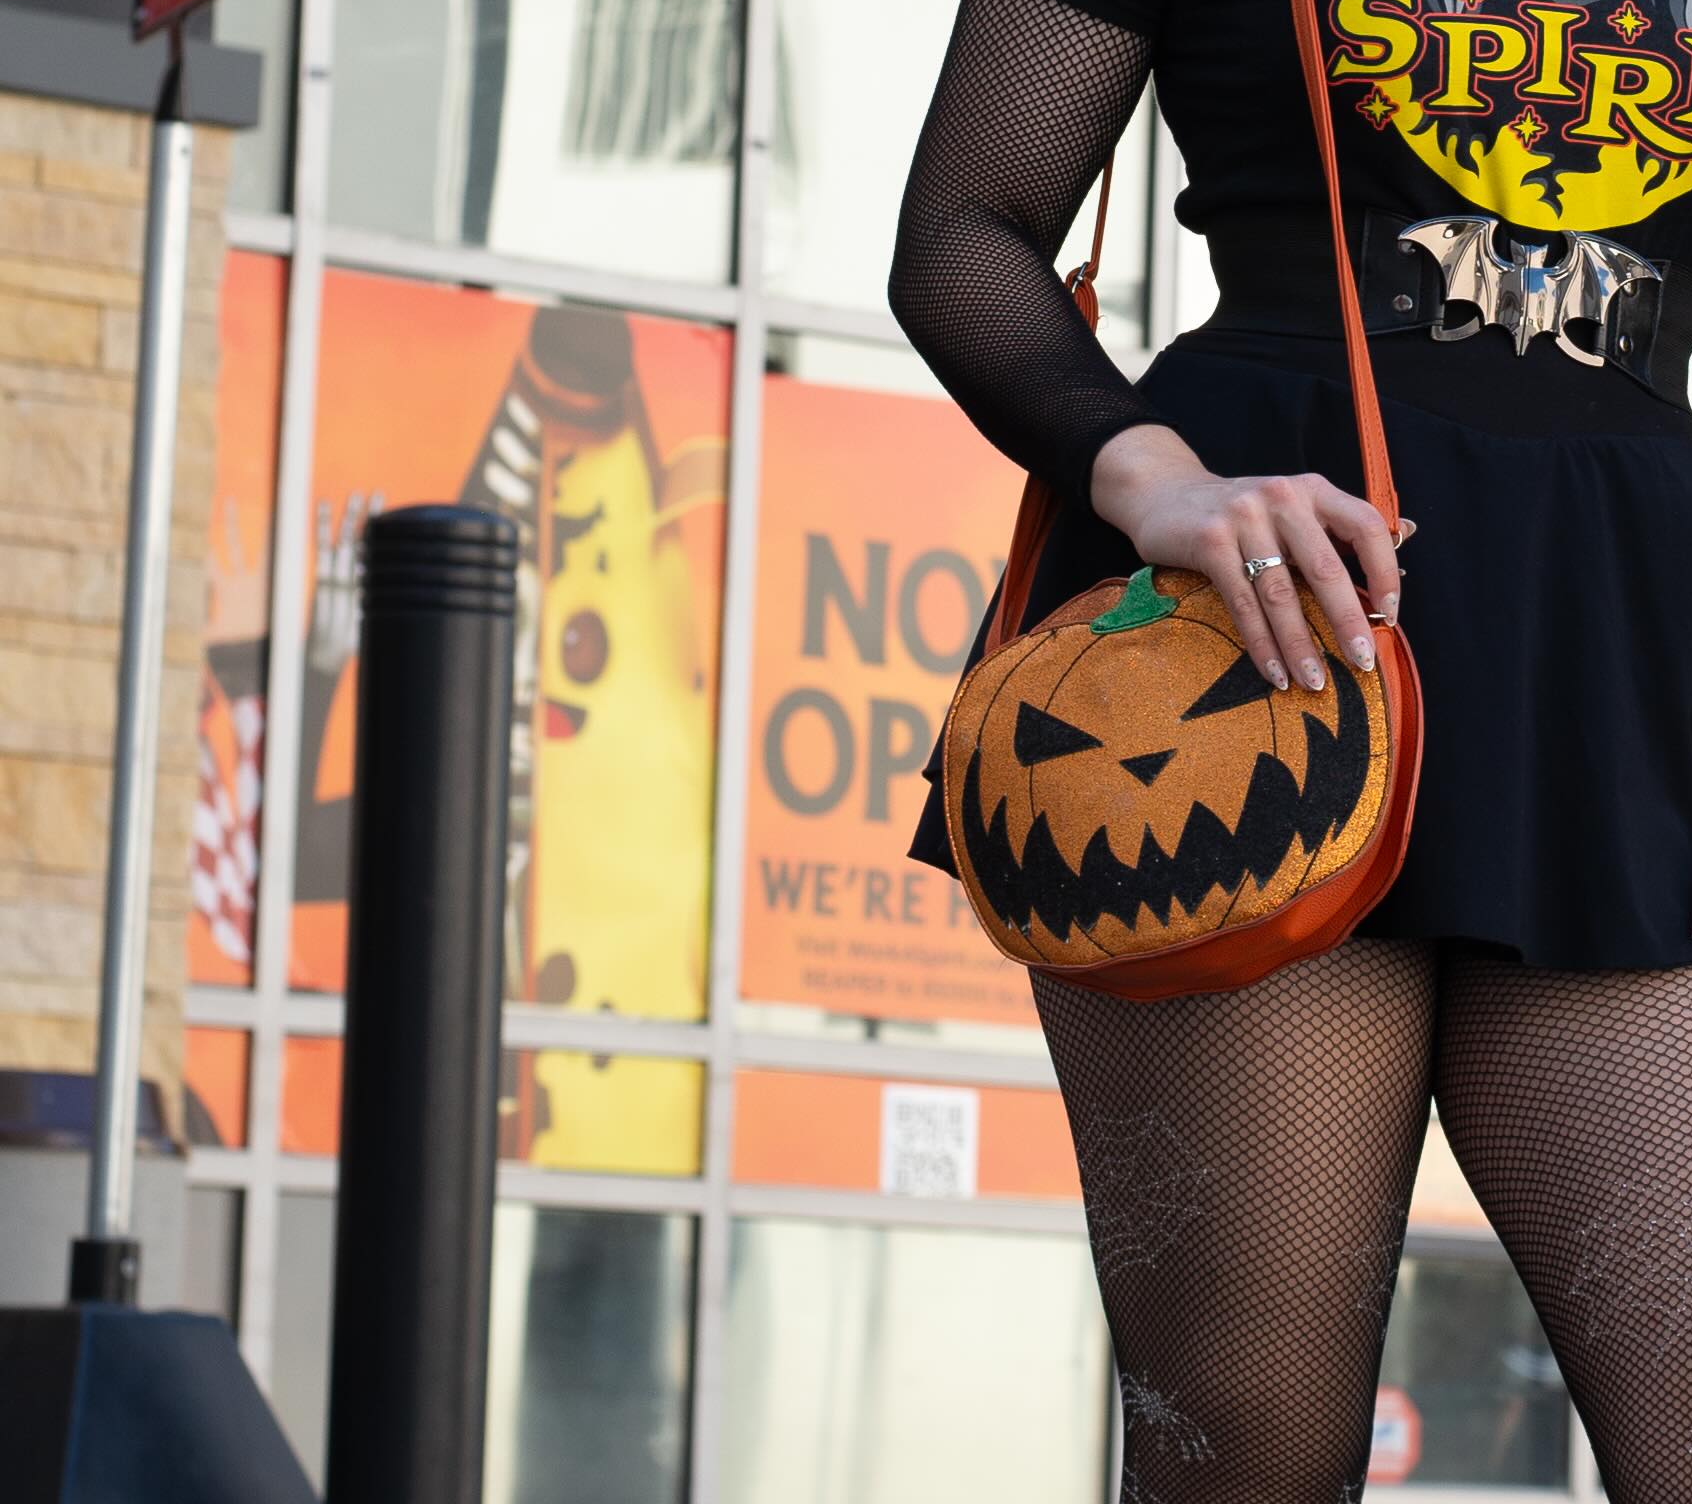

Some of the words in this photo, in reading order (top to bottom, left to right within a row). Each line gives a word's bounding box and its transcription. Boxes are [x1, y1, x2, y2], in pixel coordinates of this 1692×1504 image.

[802, 531, 1006, 676] NO
[763, 687, 945, 825] OP
[760, 857, 928, 926] WE'RE
